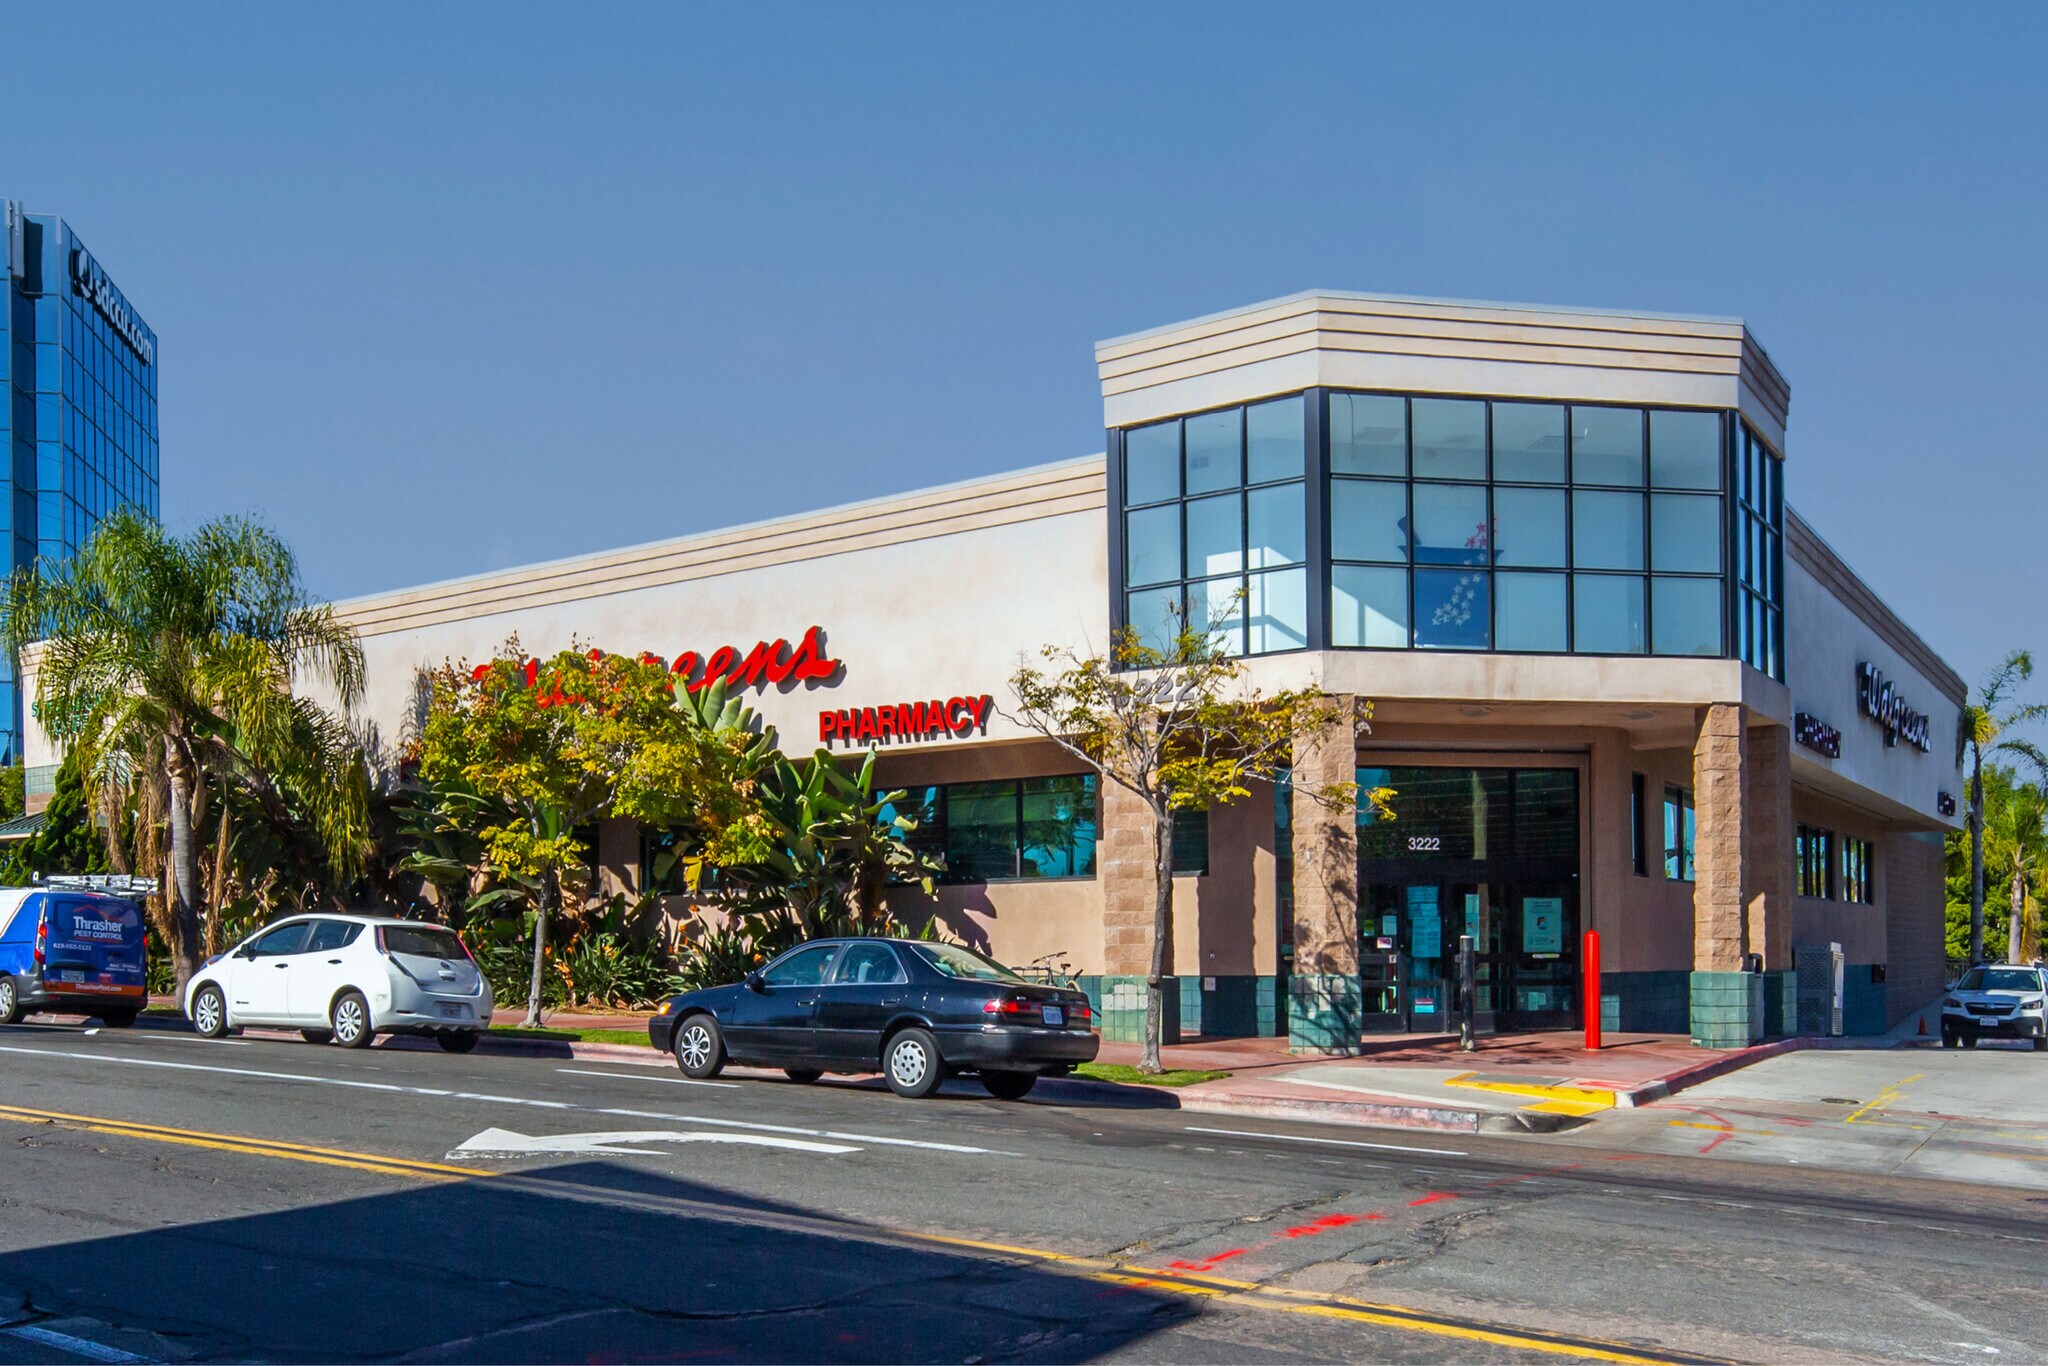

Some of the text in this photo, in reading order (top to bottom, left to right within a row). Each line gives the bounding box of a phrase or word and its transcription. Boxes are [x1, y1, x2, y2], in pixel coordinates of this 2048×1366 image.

[95, 279, 154, 366] sdccu.com
[819, 694, 988, 742] PHARMACY
[1408, 837, 1440, 851] 3222
[73, 915, 123, 933] Thrasher
[73, 930, 123, 941] PEST CONTROL
